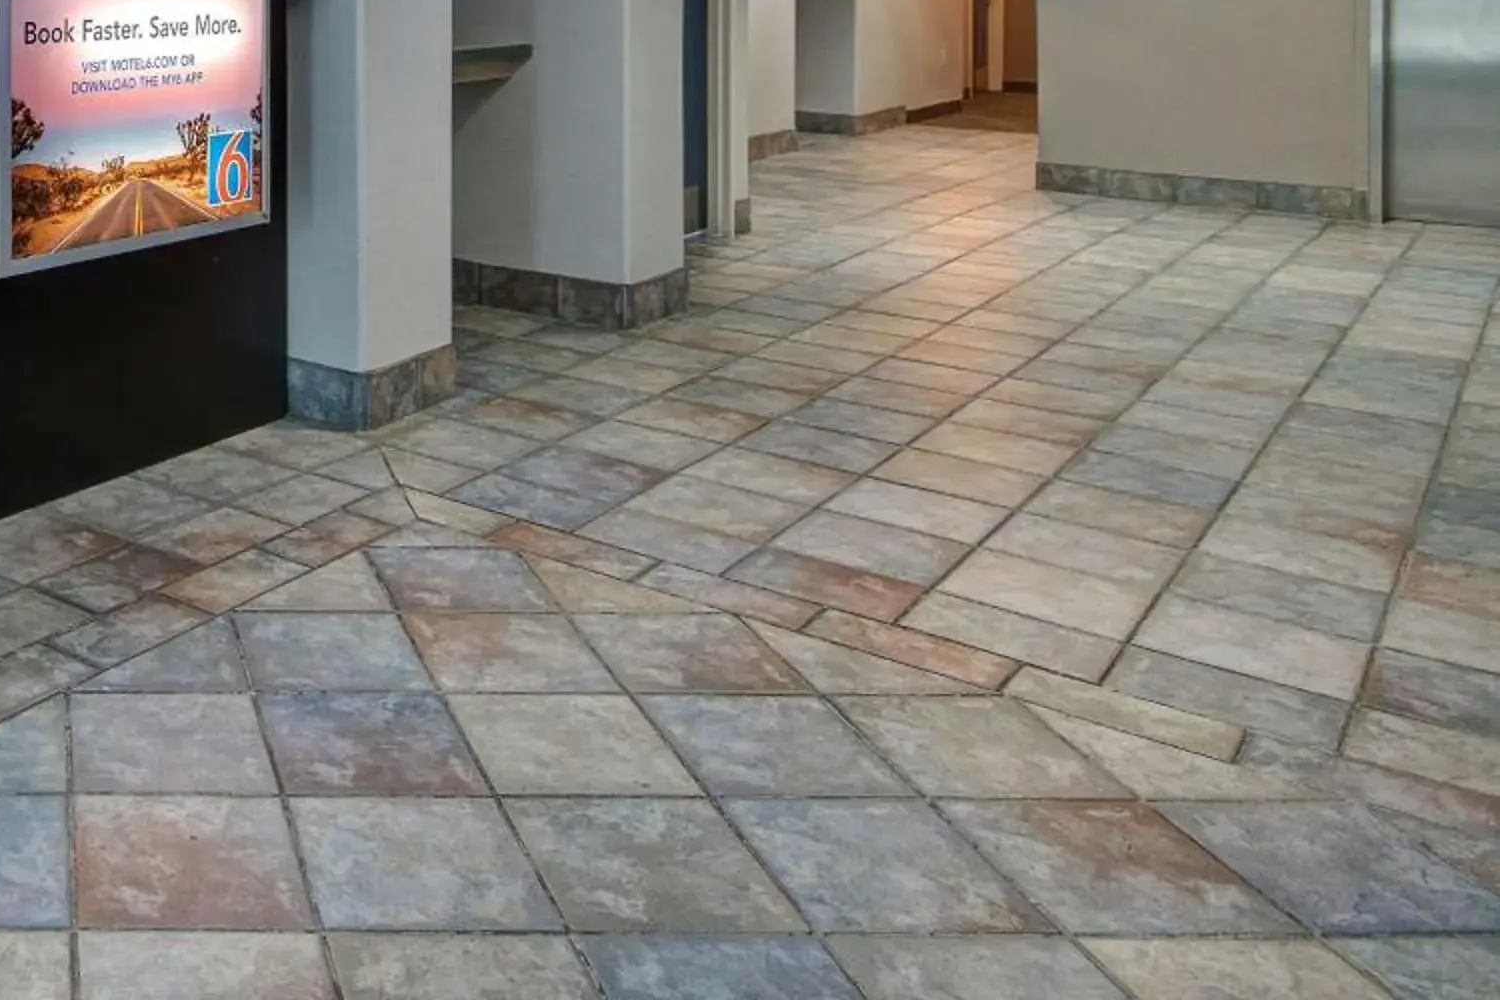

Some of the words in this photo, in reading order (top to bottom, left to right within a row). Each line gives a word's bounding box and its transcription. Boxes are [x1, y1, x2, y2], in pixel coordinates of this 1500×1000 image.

[23, 18, 75, 45] Book
[81, 18, 143, 42] Faster.
[149, 15, 189, 39] Save
[195, 13, 242, 36] More.
[81, 59, 108, 74] VISIT
[111, 55, 178, 73] MOTEL6.COM
[180, 53, 196, 67] OR
[71, 76, 137, 95] DOWNLOAD
[140, 74, 159, 88] THE
[161, 72, 182, 86] MY6
[216, 129, 249, 205] 6
